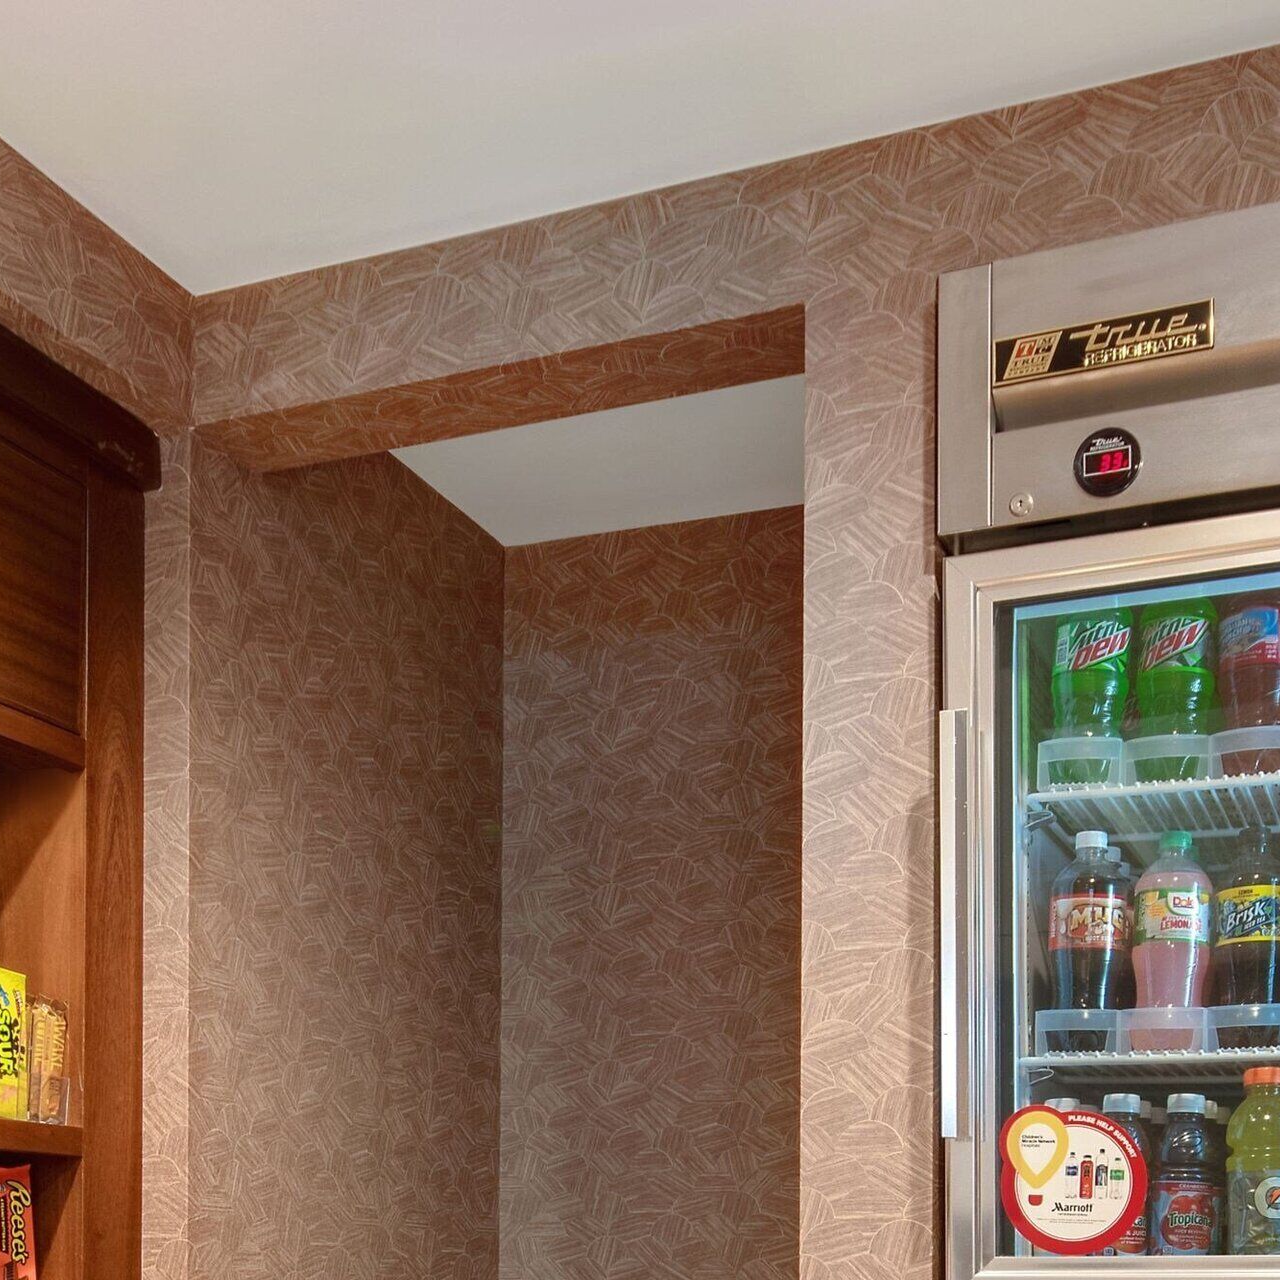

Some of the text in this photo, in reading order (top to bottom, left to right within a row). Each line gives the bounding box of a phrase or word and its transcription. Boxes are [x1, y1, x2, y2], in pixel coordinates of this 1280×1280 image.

[1084, 333, 1198, 367] REFRIGERATOR
[1068, 1115, 1137, 1159] PLEASE HELP SUPPORT
[1051, 1202, 1093, 1213] Marriott
